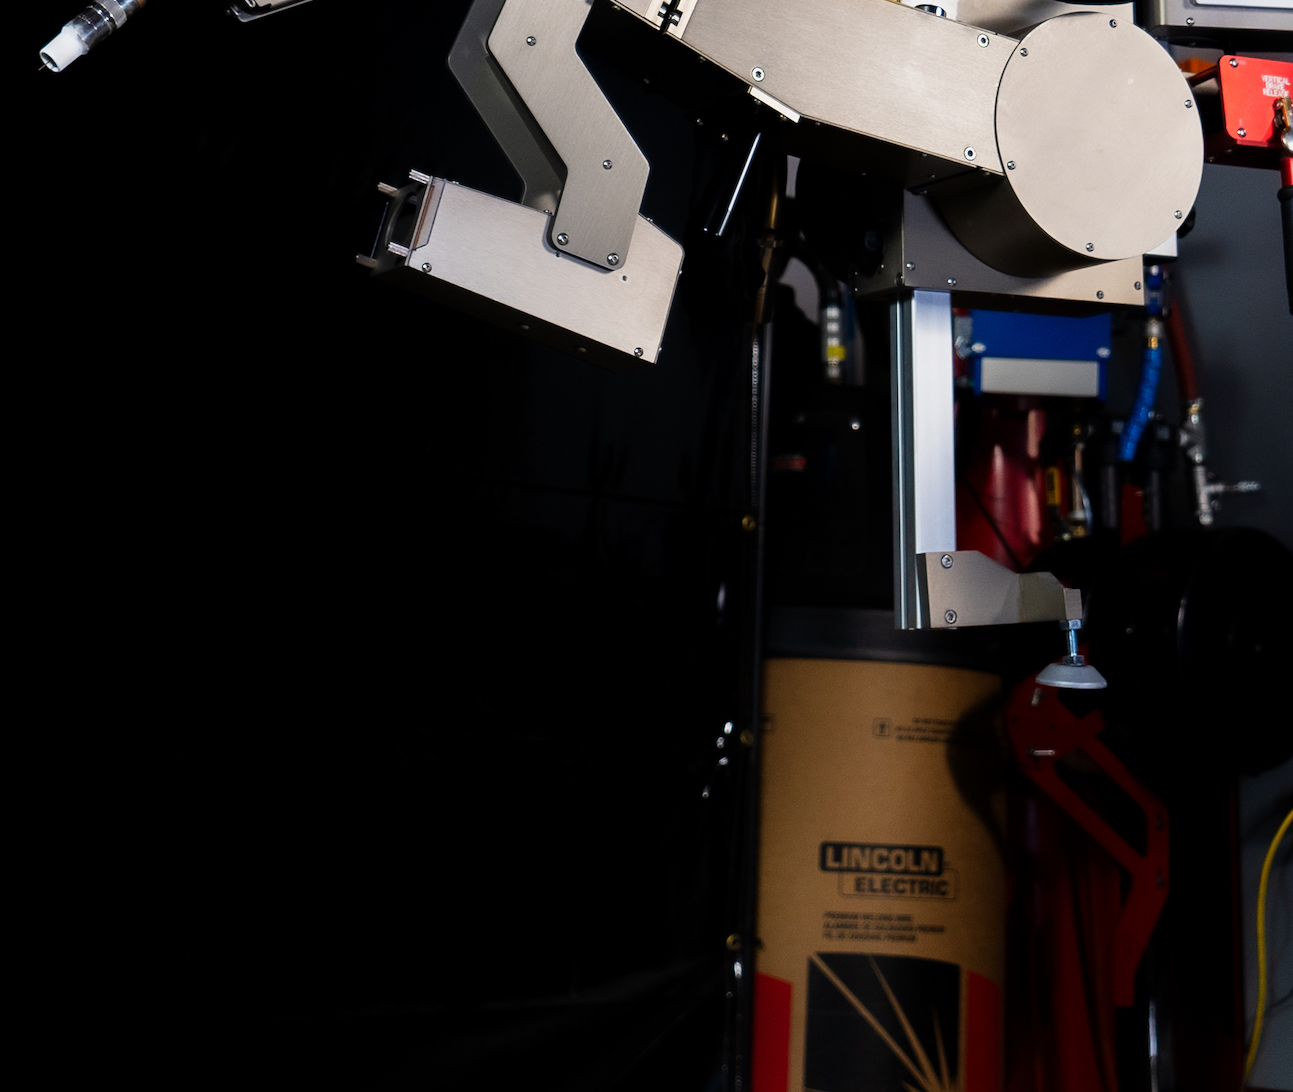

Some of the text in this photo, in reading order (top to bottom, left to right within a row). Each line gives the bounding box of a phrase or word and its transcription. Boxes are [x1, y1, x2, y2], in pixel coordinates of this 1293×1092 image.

[1261, 75, 1290, 86] VERTICAL
[1262, 88, 1290, 98] RELEASE
[825, 844, 940, 873] LINCOLN
[854, 877, 948, 896] ELECTRIC
